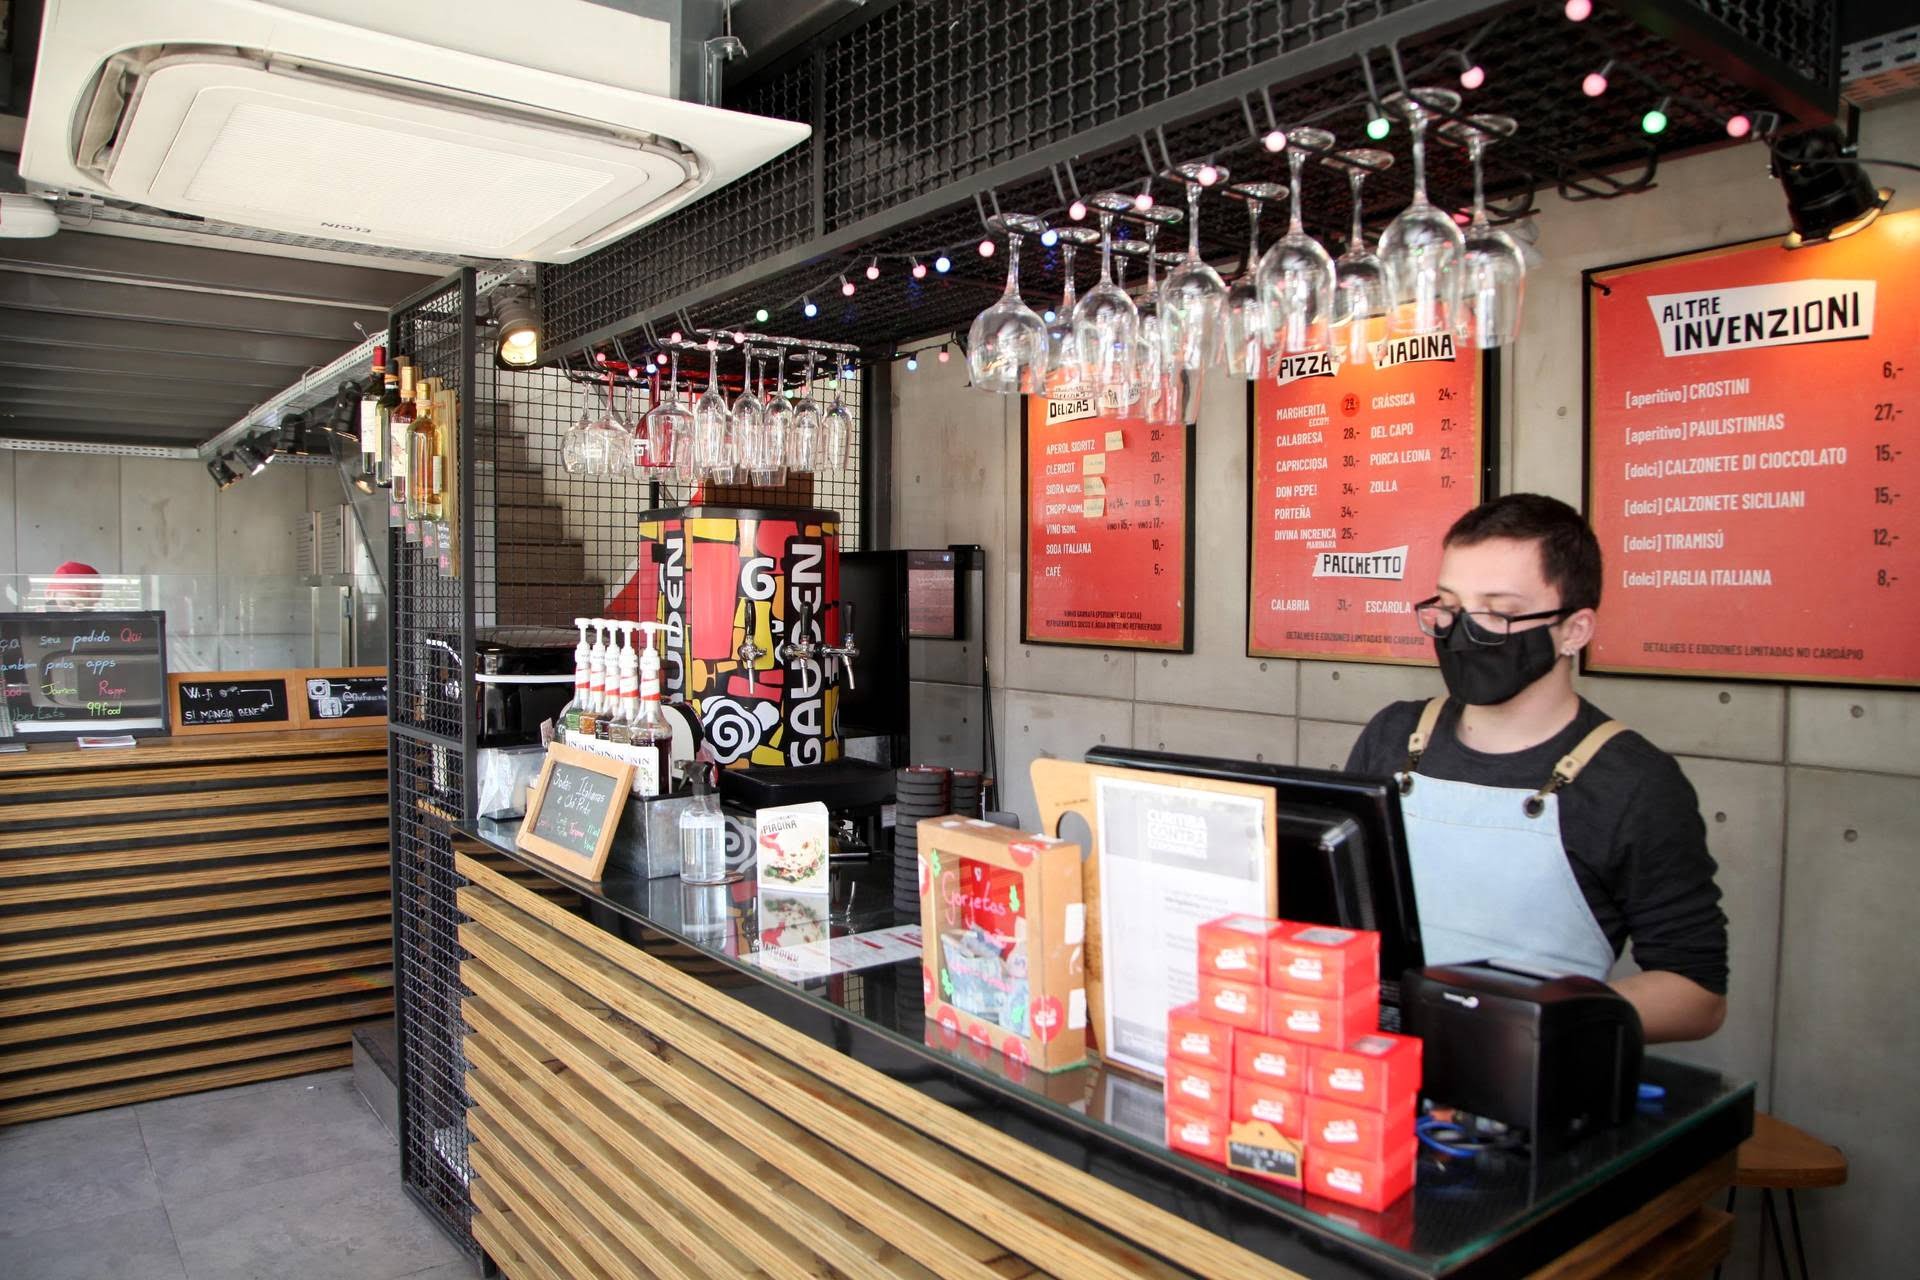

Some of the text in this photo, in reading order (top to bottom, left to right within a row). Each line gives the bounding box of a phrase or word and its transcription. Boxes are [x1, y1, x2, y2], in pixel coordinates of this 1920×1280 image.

[1663, 297, 1720, 323] ALTRE
[1675, 291, 1859, 351] INVENZIONI
[1279, 353, 1332, 379] PIZZA
[1372, 391, 1415, 409] CRÁSSICA
[1625, 385, 1687, 409] [aperitivo]
[1690, 378, 1750, 400] CROSTINI
[1050, 400, 1089, 418] DELIZIAS
[1276, 403, 1326, 421] MARGHERITA
[1370, 425, 1387, 439] DEL
[1389, 422, 1413, 437] CAPO
[1625, 422, 1687, 445] [aperitivo]
[1690, 413, 1785, 438] PAULISTINHAS
[1277, 431, 1323, 447] CALABRESA
[1046, 443, 1070, 455] APEROL
[1370, 452, 1399, 466] PORCA
[1401, 448, 1431, 464] LEONA
[1276, 457, 1328, 472] CAPRICCIOSA
[1625, 460, 1663, 480] [dolci]
[1665, 455, 1739, 475] CALZONETE
[1743, 453, 1756, 471] DI
[1760, 446, 1847, 470] CIOCCOLATO
[1276, 486, 1292, 498] DON
[1294, 484, 1317, 497] PEPE!
[1370, 479, 1397, 493] ZOLLA
[1274, 504, 1311, 519] PORTEÑA
[1624, 499, 1662, 517] [dolci]
[1665, 494, 1739, 513] CALZONETE
[1742, 490, 1805, 510] SICILIANI
[1274, 529, 1298, 541] DIVINA
[1623, 535, 1661, 552] [dolci]
[1063, 543, 1091, 554] ITALIANA
[1045, 563, 1061, 576] CAFÉ
[1323, 554, 1401, 575] PACCHETTO
[1623, 570, 1661, 588] [dolci]
[1663, 570, 1708, 586] PAGLIA
[1711, 570, 1773, 586] ITALIANA
[1271, 599, 1309, 611] CALABRIA
[1366, 601, 1411, 614] ESCAROLA
[40, 636, 61, 646] seu
[71, 630, 111, 653] pedido
[1643, 642, 1687, 653] DETALHES
[1745, 645, 1794, 658] LIMITADAS
[86, 659, 117, 675] apps
[762, 820, 797, 834] PIADINA
[941, 870, 1007, 929] Gorjetas
